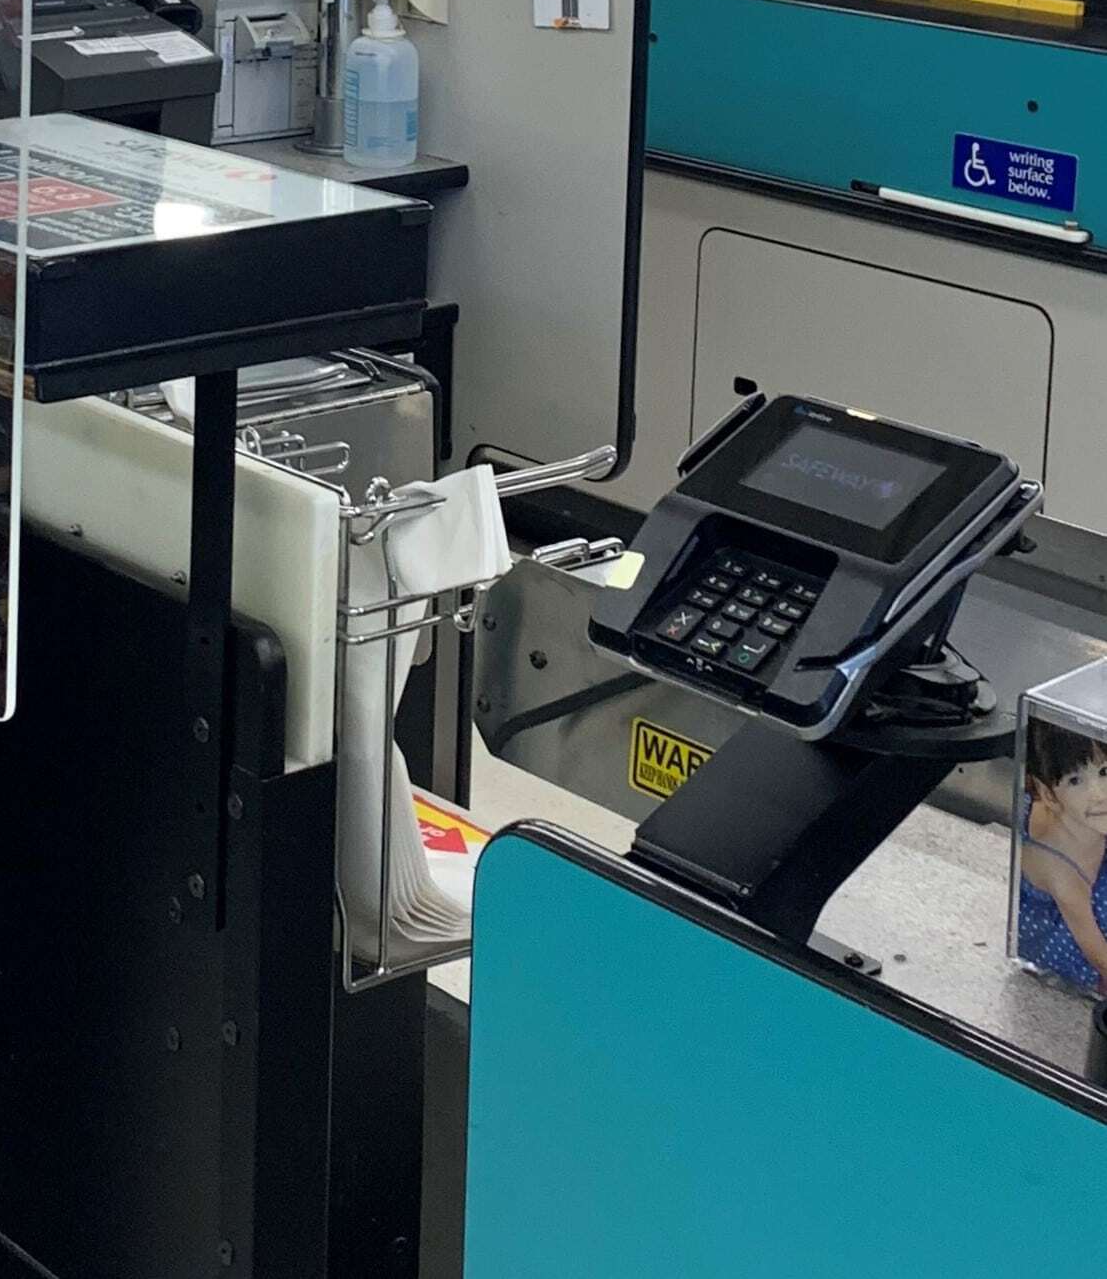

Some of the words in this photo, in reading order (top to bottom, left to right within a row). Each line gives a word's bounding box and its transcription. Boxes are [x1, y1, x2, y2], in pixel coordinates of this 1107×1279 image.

[1008, 151, 1054, 174] writing
[1007, 166, 1054, 185] surface
[1007, 178, 1052, 200] below.
